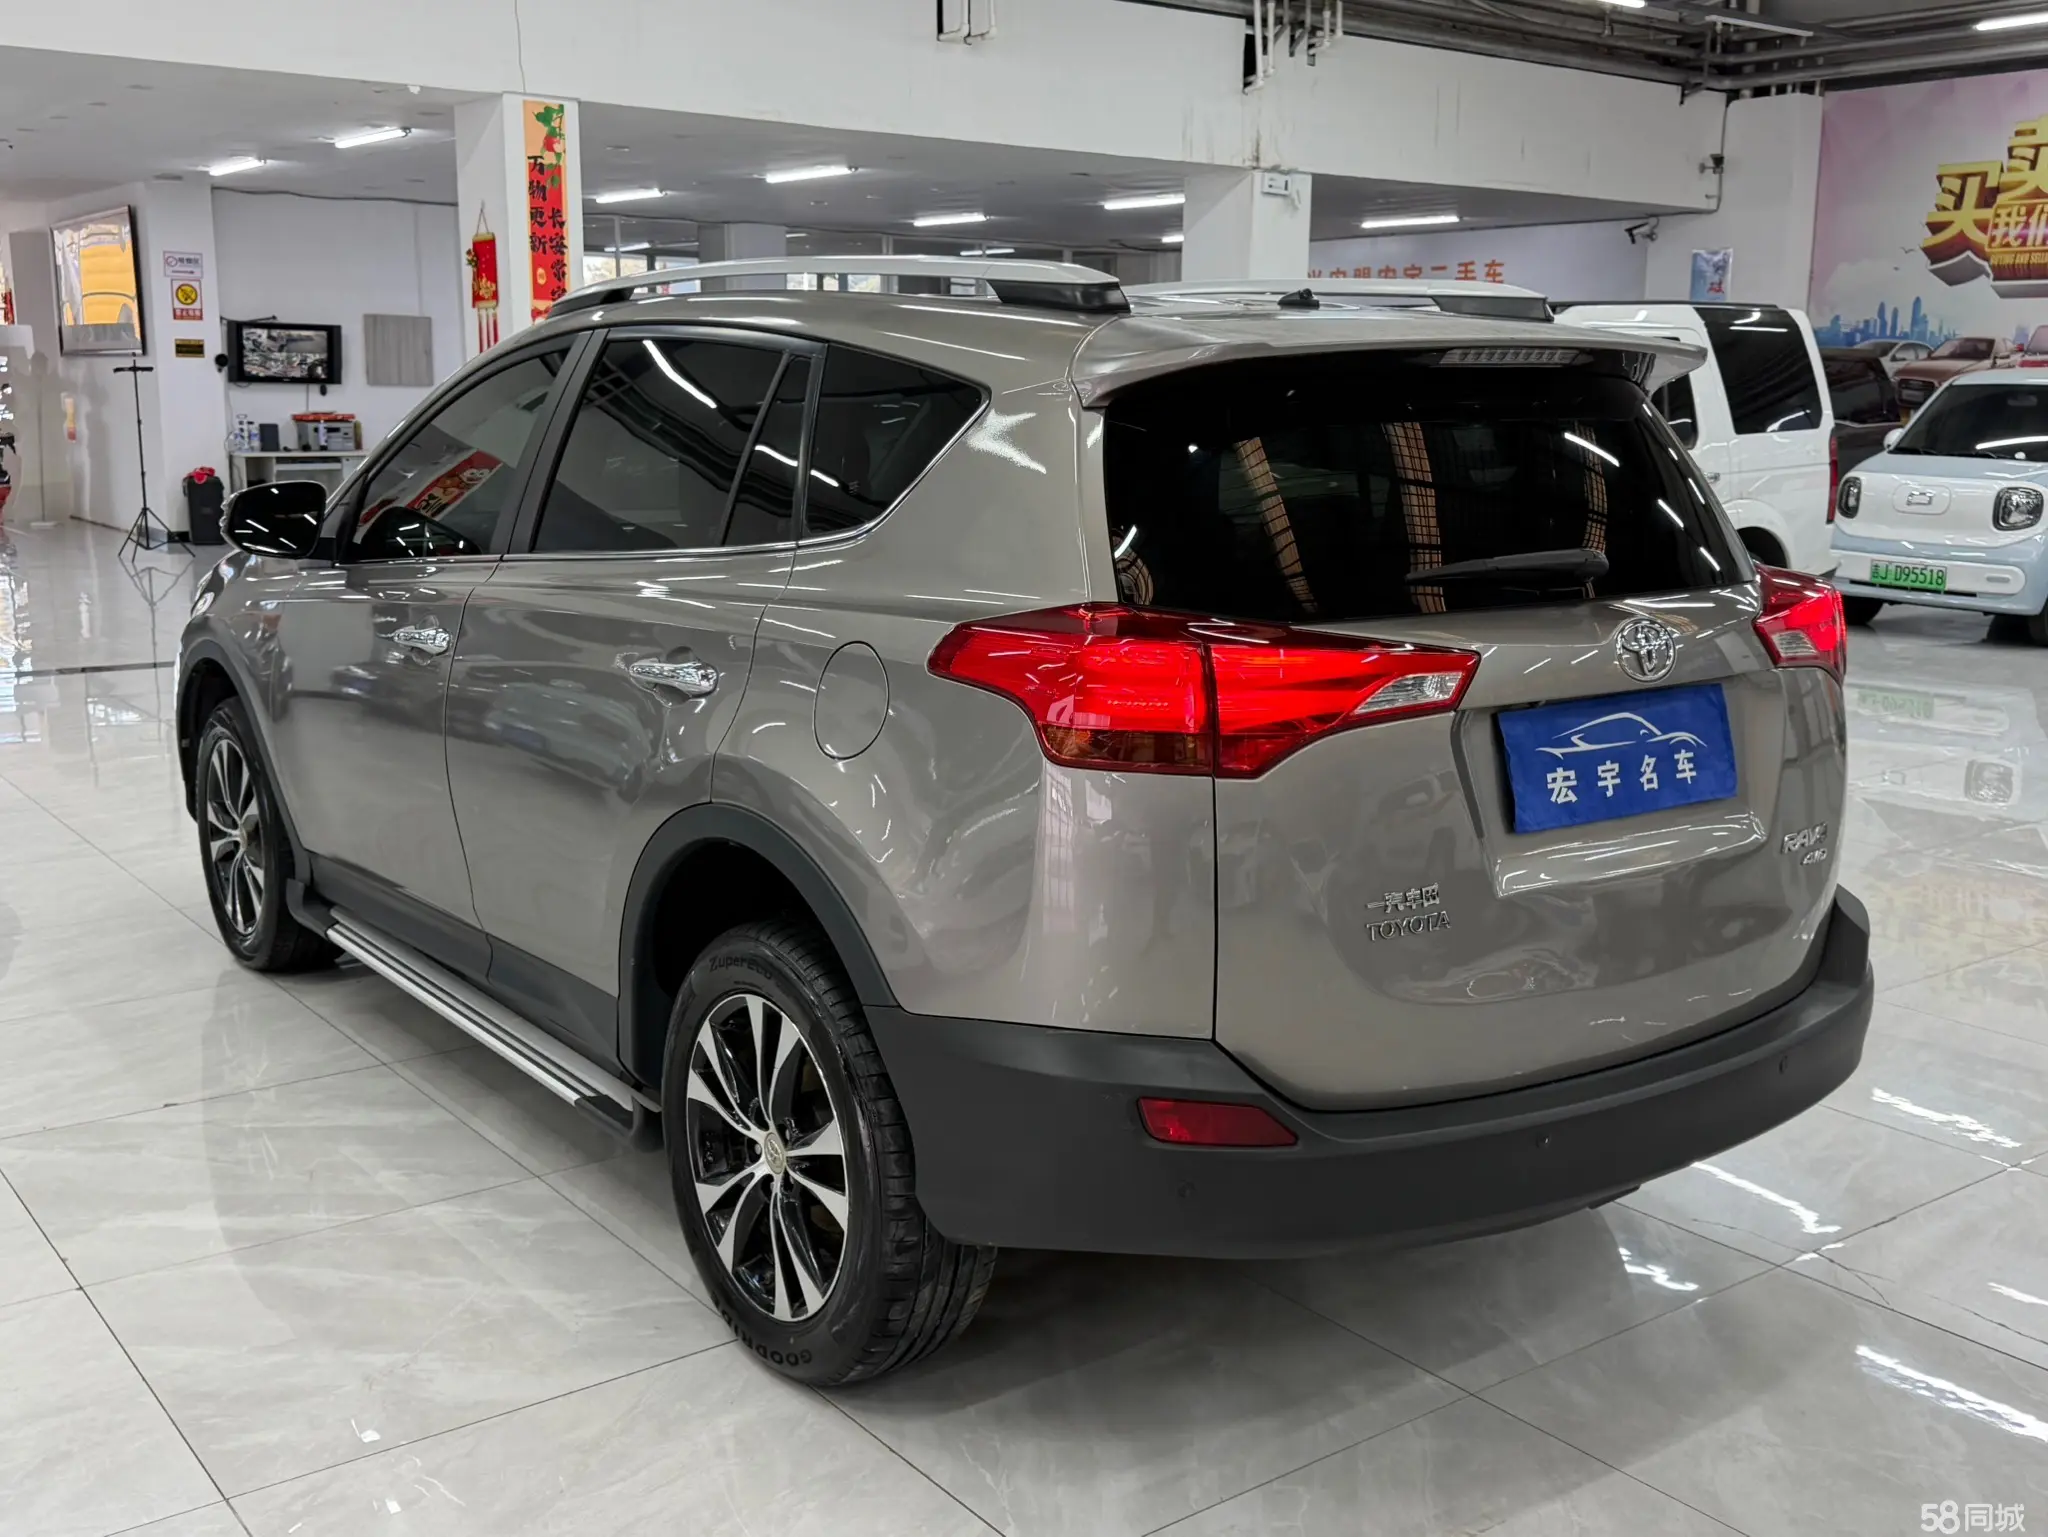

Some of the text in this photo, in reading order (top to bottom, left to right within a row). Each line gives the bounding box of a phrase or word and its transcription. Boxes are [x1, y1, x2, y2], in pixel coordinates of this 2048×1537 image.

[527, 156, 548, 254] 万物更新
[1546, 749, 1697, 804] 宏宇名车
[1366, 882, 1440, 914] 一汽丰田
[1366, 910, 1451, 941] TOYOTA
